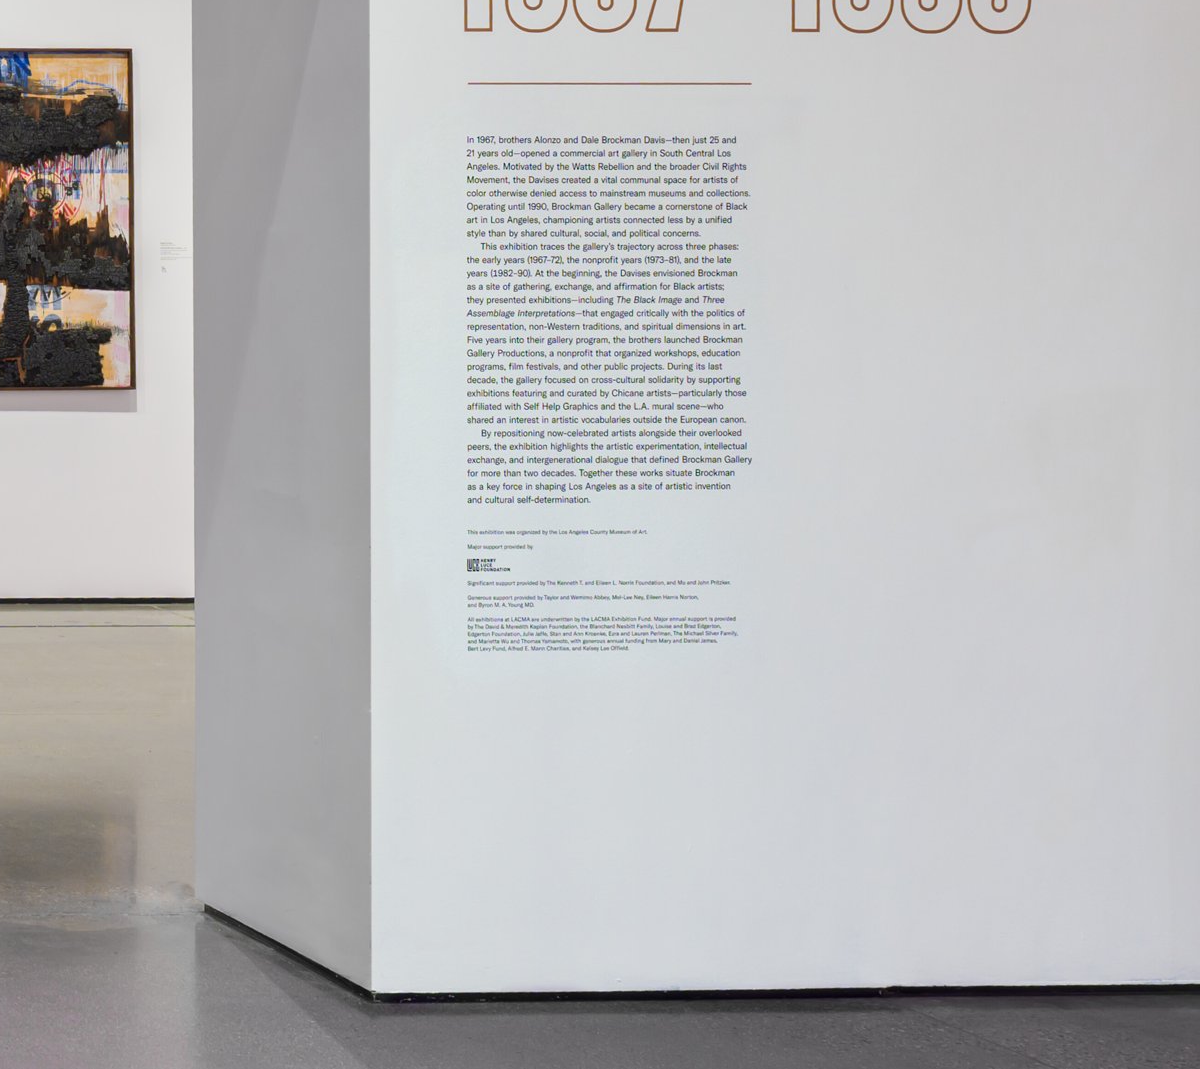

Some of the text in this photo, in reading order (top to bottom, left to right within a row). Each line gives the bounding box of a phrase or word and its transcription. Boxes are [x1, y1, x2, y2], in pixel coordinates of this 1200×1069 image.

[476, 135, 496, 145] 1967,
[498, 136, 532, 144] brothers
[534, 136, 562, 144] Alonzo
[563, 136, 579, 144] and
[581, 135, 599, 144] Dale
[601, 135, 642, 144] Brockman
[692, 136, 707, 146] just
[709, 136, 720, 144] 25
[721, 136, 737, 144] and
[466, 149, 475, 157] 21
[477, 150, 499, 159] years
[559, 149, 606, 157] commercial
[607, 150, 620, 158] art
[621, 149, 648, 159] gallery
[650, 149, 658, 157] in
[659, 149, 684, 158] South
[685, 149, 715, 158] Central
[717, 149, 732, 157] Los
[466, 162, 747, 173] Angeles. Motivated by the Watts Rebellion and the broader Civil Rights
[466, 175, 511, 185] Movement,
[512, 176, 526, 184] the
[528, 175, 560, 184] Davises
[561, 176, 591, 184] created
[600, 176, 618, 184] vital
[619, 176, 661, 184] communal
[663, 177, 687, 185] space
[689, 175, 701, 184] for
[702, 176, 729, 184] artists
[730, 176, 739, 184] of
[466, 189, 487, 197] color
[488, 189, 528, 197] otherwise
[529, 189, 557, 198] denied
[589, 190, 598, 198] to
[599, 189, 646, 197] mainstream
[688, 189, 704, 197] and
[706, 189, 751, 197] collections.
[466, 202, 506, 213] Operating
[507, 202, 525, 211] until
[527, 202, 549, 211] 1990,
[551, 202, 592, 211] Brockman
[593, 202, 622, 212] Gallery
[624, 202, 656, 211] became
[665, 203, 713, 211] cornerstone
[714, 202, 724, 211] of
[725, 202, 748, 211] Black
[490, 216, 505, 224] Los
[506, 215, 541, 226] Angeles,
[542, 216, 594, 226] championing
[595, 216, 621, 224] artists
[622, 216, 665, 224] connected
[667, 216, 684, 224] less
[685, 216, 696, 226] by
[705, 215, 733, 224] unified
[466, 229, 486, 239] style
[488, 229, 506, 237] than
[508, 229, 519, 239] by
[520, 229, 548, 237] shared
[549, 229, 582, 238] cultural,
[584, 229, 610, 238] social,
[611, 229, 627, 237] and
[629, 229, 660, 239] political
[466, 296, 484, 306] they
[486, 295, 527, 305] presented
[616, 295, 632, 304] The
[633, 295, 656, 304] Black
[658, 296, 683, 306] Image
[684, 296, 700, 304] and
[702, 295, 725, 304] Three
[466, 309, 516, 319] Assemblage
[600, 309, 634, 319] engaged
[636, 309, 670, 319] critically
[671, 309, 689, 317] with
[690, 309, 704, 317] the
[706, 309, 735, 318] politics
[736, 309, 745, 317] of
[481, 429, 742, 439] By repositioning now-celebrated artists alongside their overlooked
[467, 469, 479, 477] for
[503, 469, 522, 478] than
[540, 469, 577, 477] decades.
[578, 468, 614, 479] Together
[615, 469, 638, 477] these
[639, 469, 664, 477] works
[665, 469, 693, 477] situate
[695, 468, 735, 477] Brockman
[467, 495, 591, 504] and cultural self-determination.
